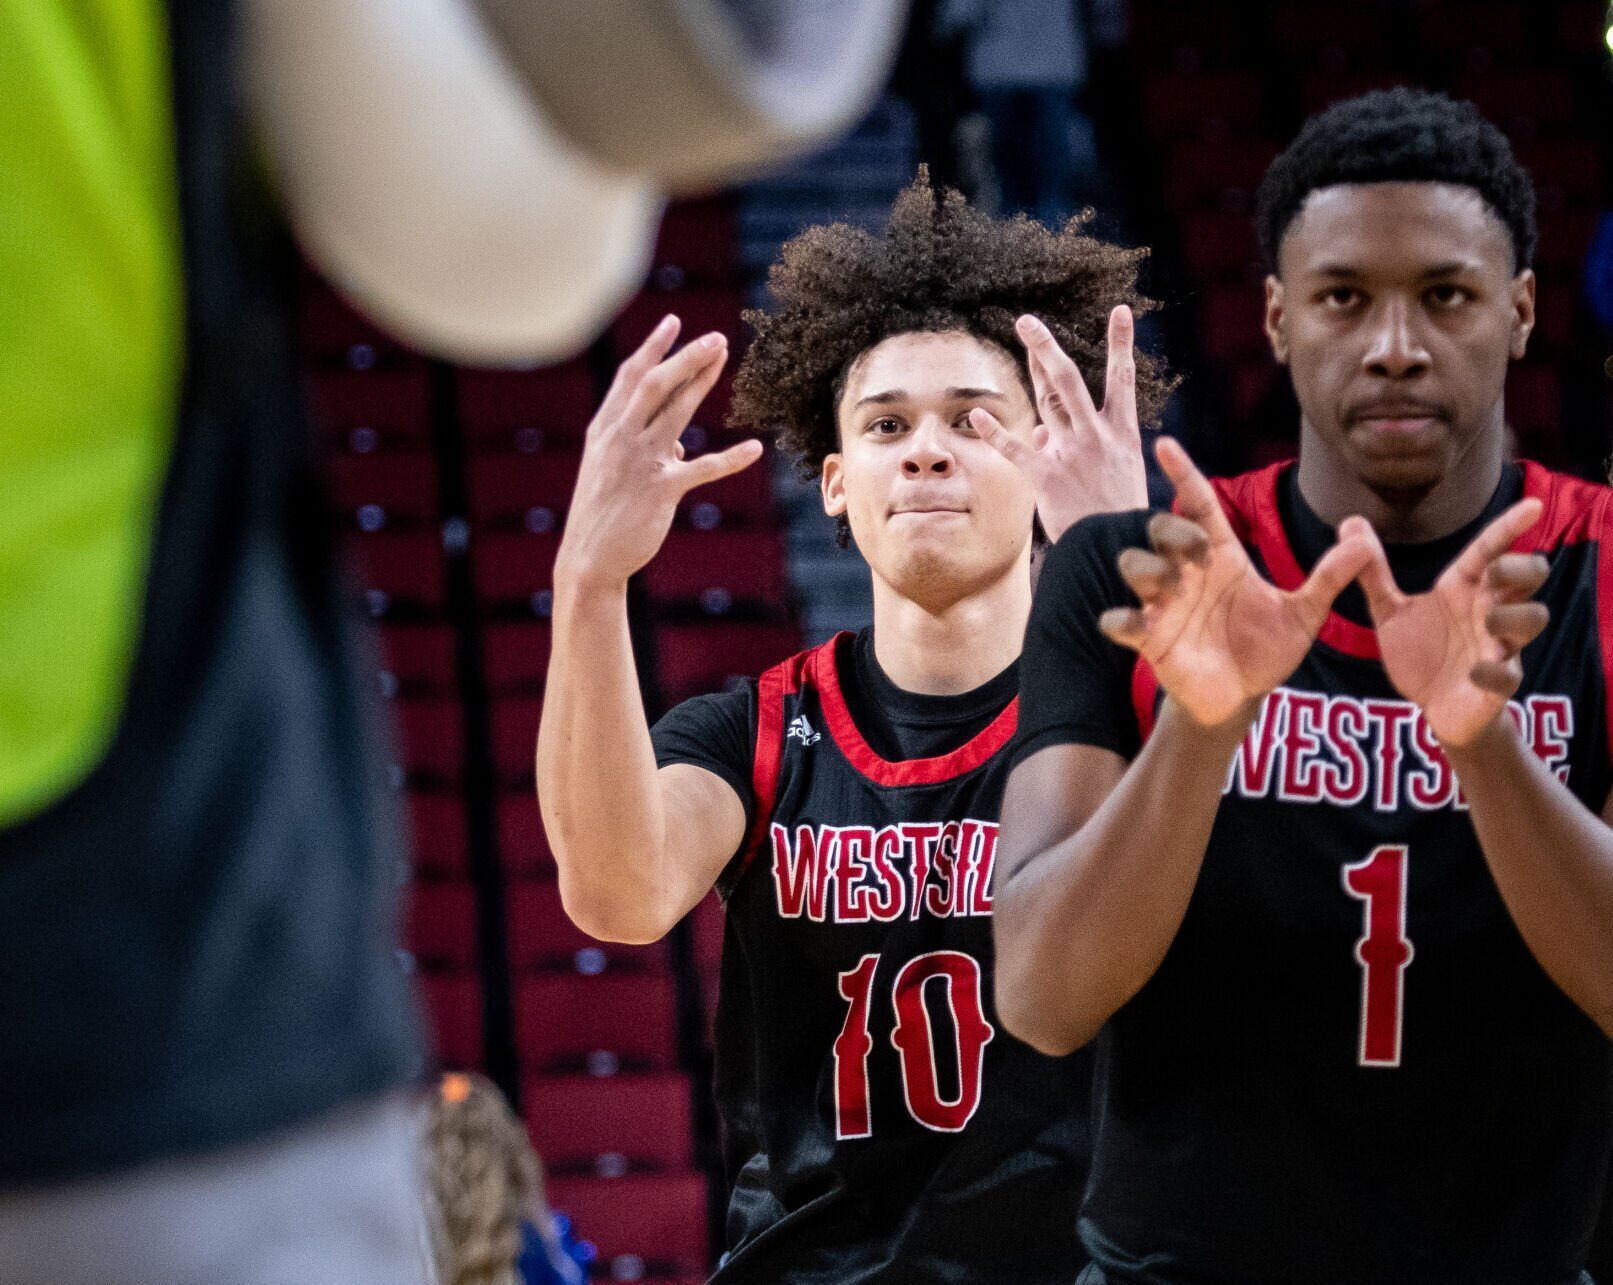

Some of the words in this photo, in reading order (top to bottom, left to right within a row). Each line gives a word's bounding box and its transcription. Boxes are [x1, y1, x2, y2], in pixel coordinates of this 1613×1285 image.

[1221, 686, 1574, 812] WESTSE
[771, 818, 1000, 923] WESTSI
[1342, 844, 1414, 1067] 1
[833, 950, 995, 1140] 10
